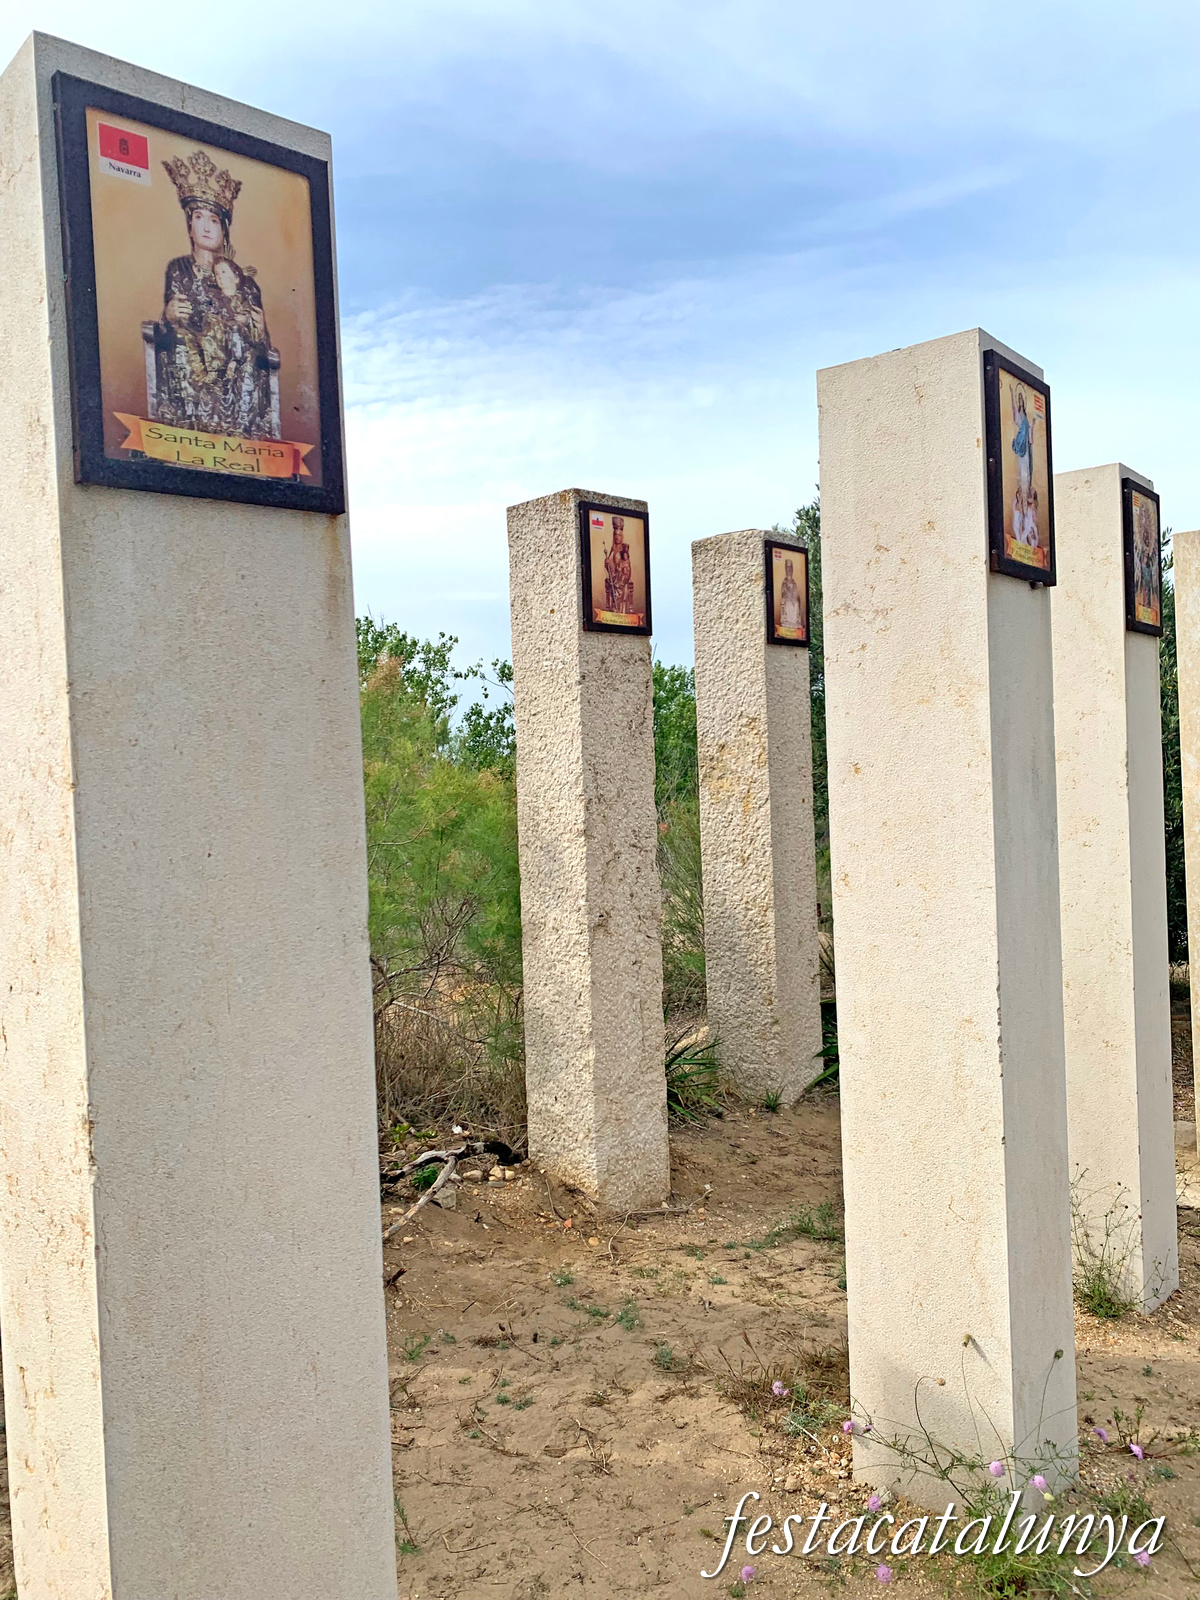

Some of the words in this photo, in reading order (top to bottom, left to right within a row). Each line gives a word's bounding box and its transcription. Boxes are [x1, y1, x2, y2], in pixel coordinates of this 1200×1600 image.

[108, 161, 142, 178] Navarra
[145, 427, 216, 449] Santa
[176, 450, 205, 466] La
[212, 456, 261, 473] Real
